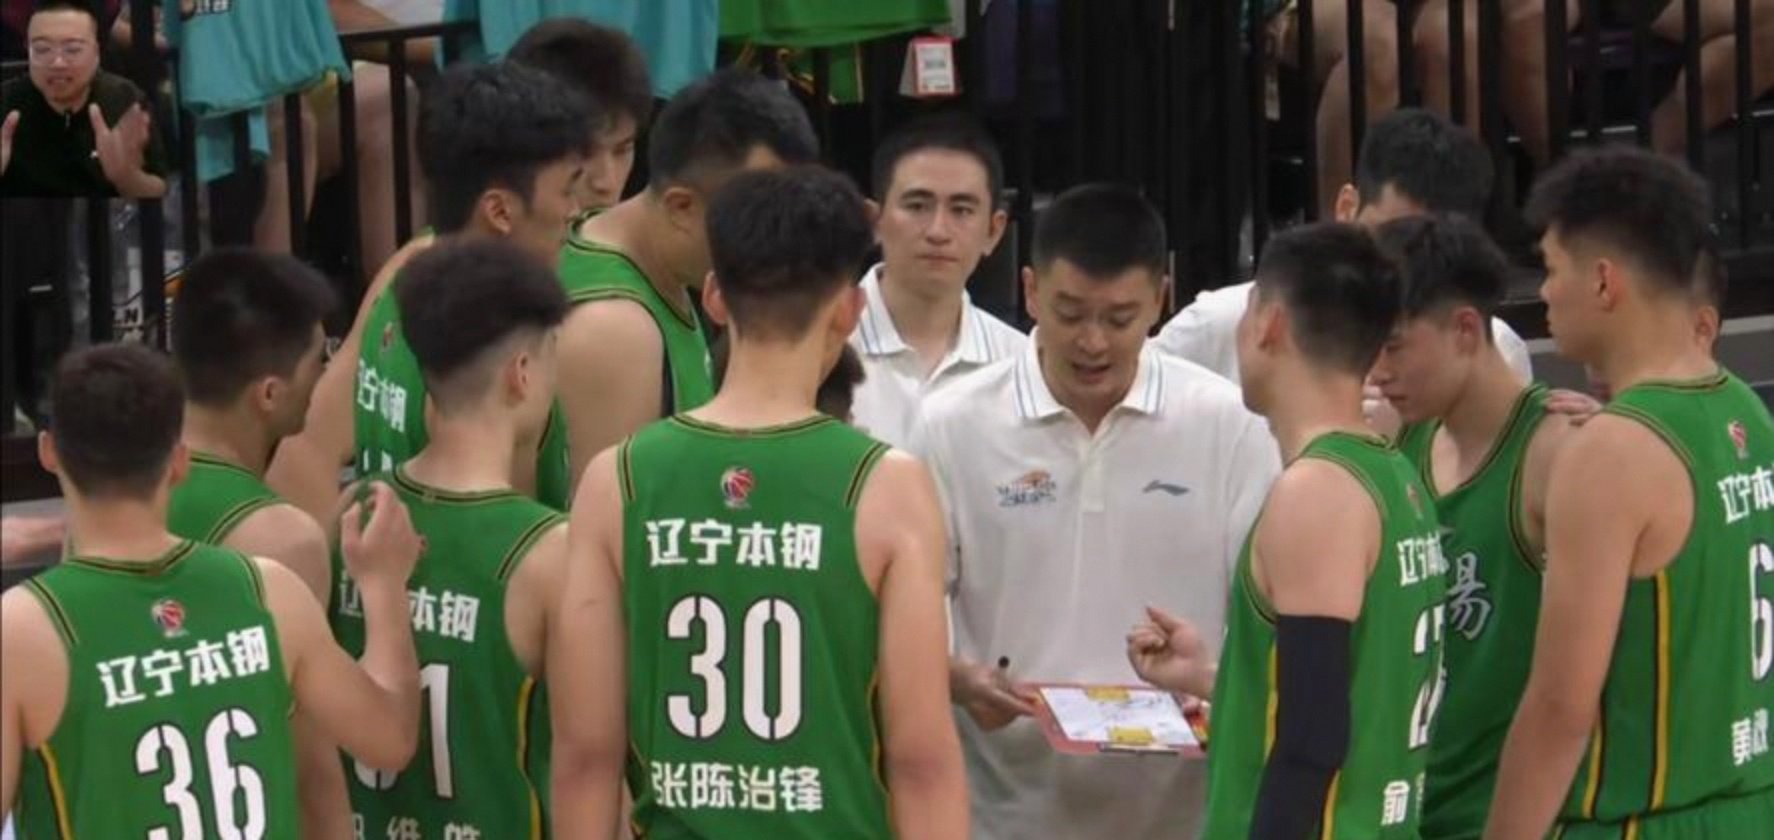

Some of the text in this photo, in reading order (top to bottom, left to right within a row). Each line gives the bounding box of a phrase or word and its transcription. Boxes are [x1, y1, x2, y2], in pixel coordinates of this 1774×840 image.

[1716, 464, 1774, 524] 辽宁本
[644, 518, 823, 571] 辽宁本钢
[96, 625, 271, 708] 辽宁本钢
[667, 596, 801, 740] 30
[135, 708, 266, 840] 36
[651, 761, 824, 813] 张陈治锋
